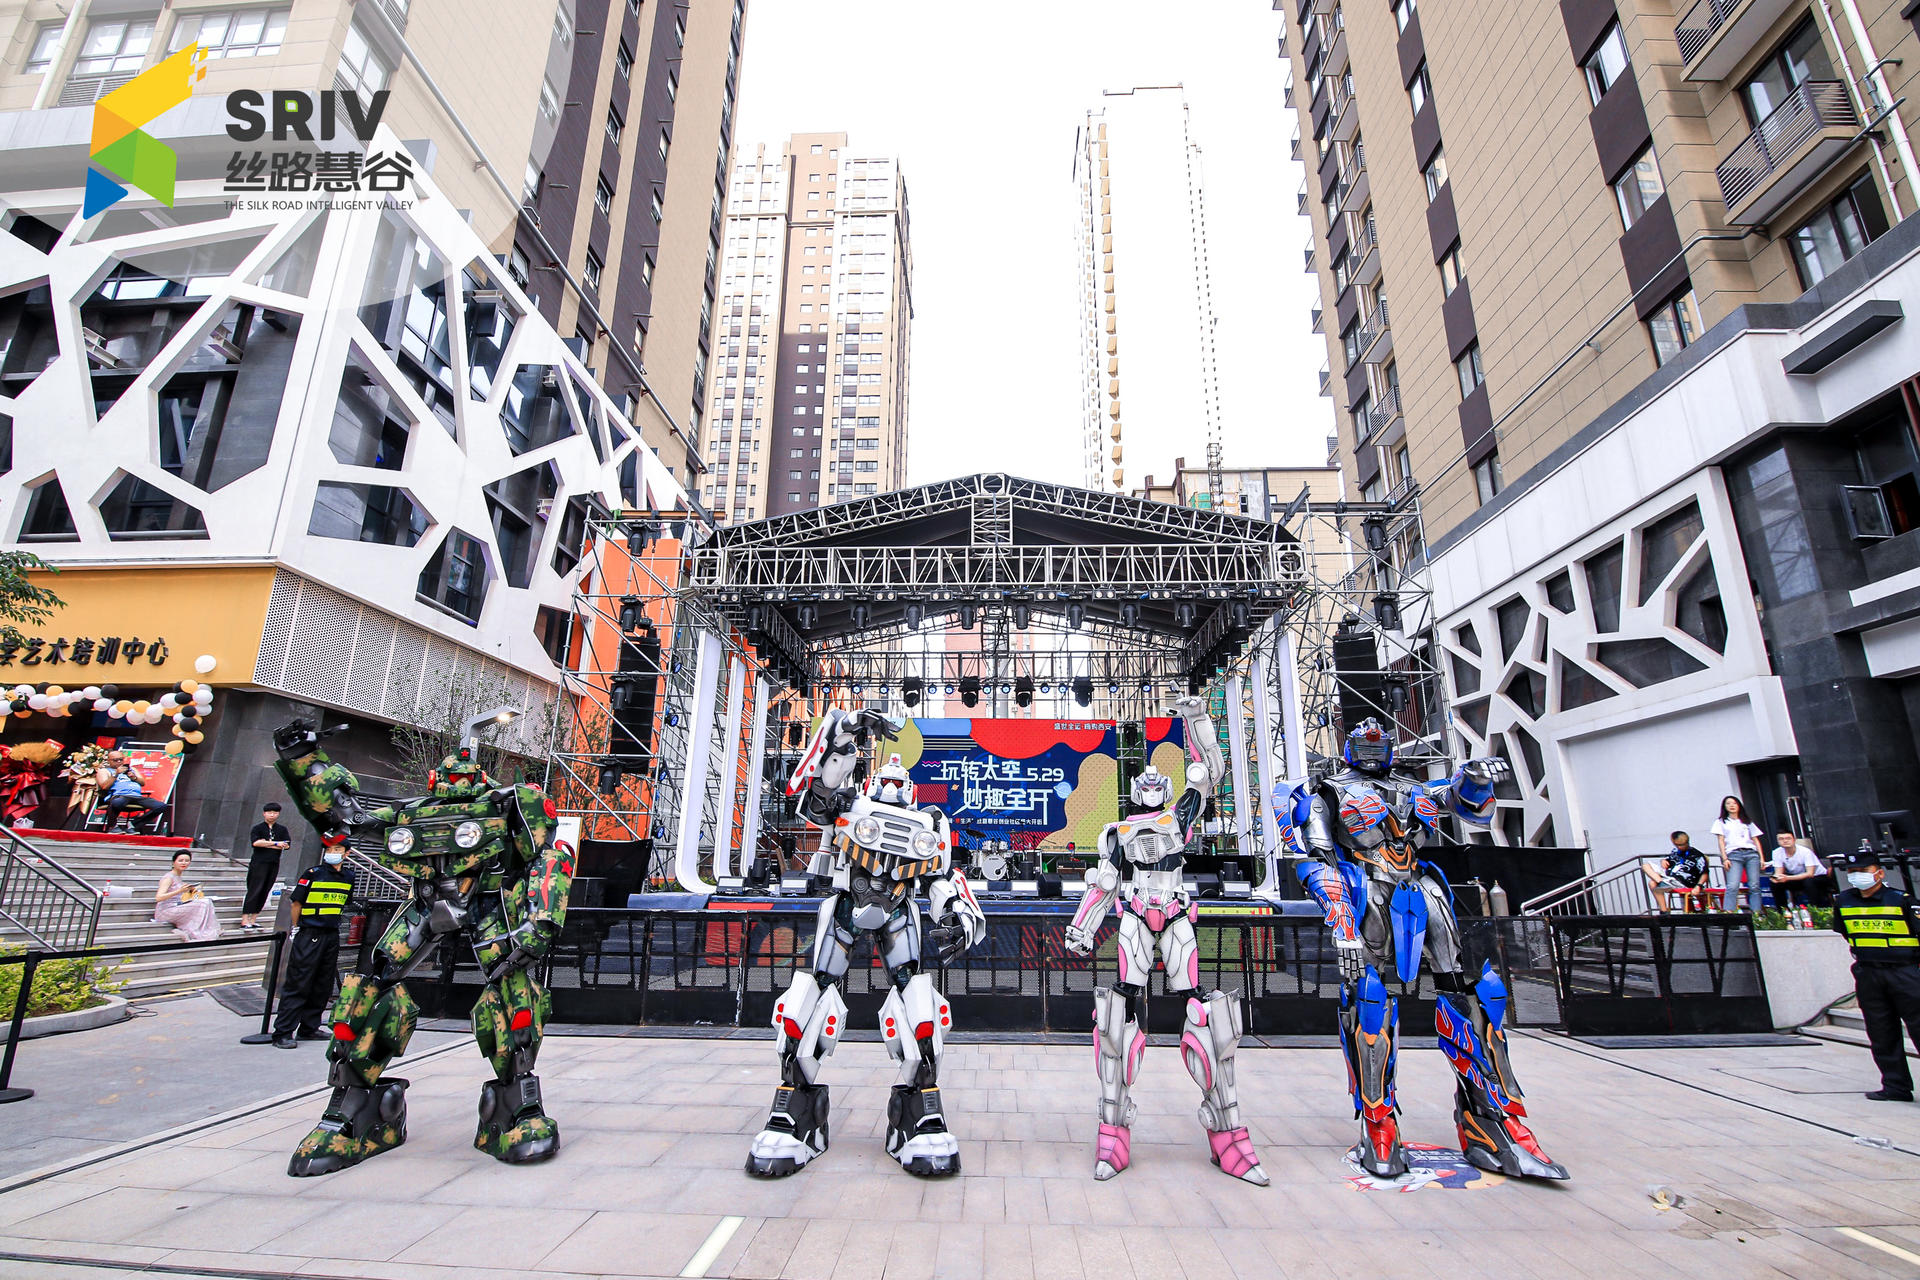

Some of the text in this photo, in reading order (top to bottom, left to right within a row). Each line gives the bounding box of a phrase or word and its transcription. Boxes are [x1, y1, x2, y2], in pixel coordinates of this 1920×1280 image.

[932, 755, 1064, 782] 玩转太空 5.29
[956, 784, 1053, 822] 妙趣全开
